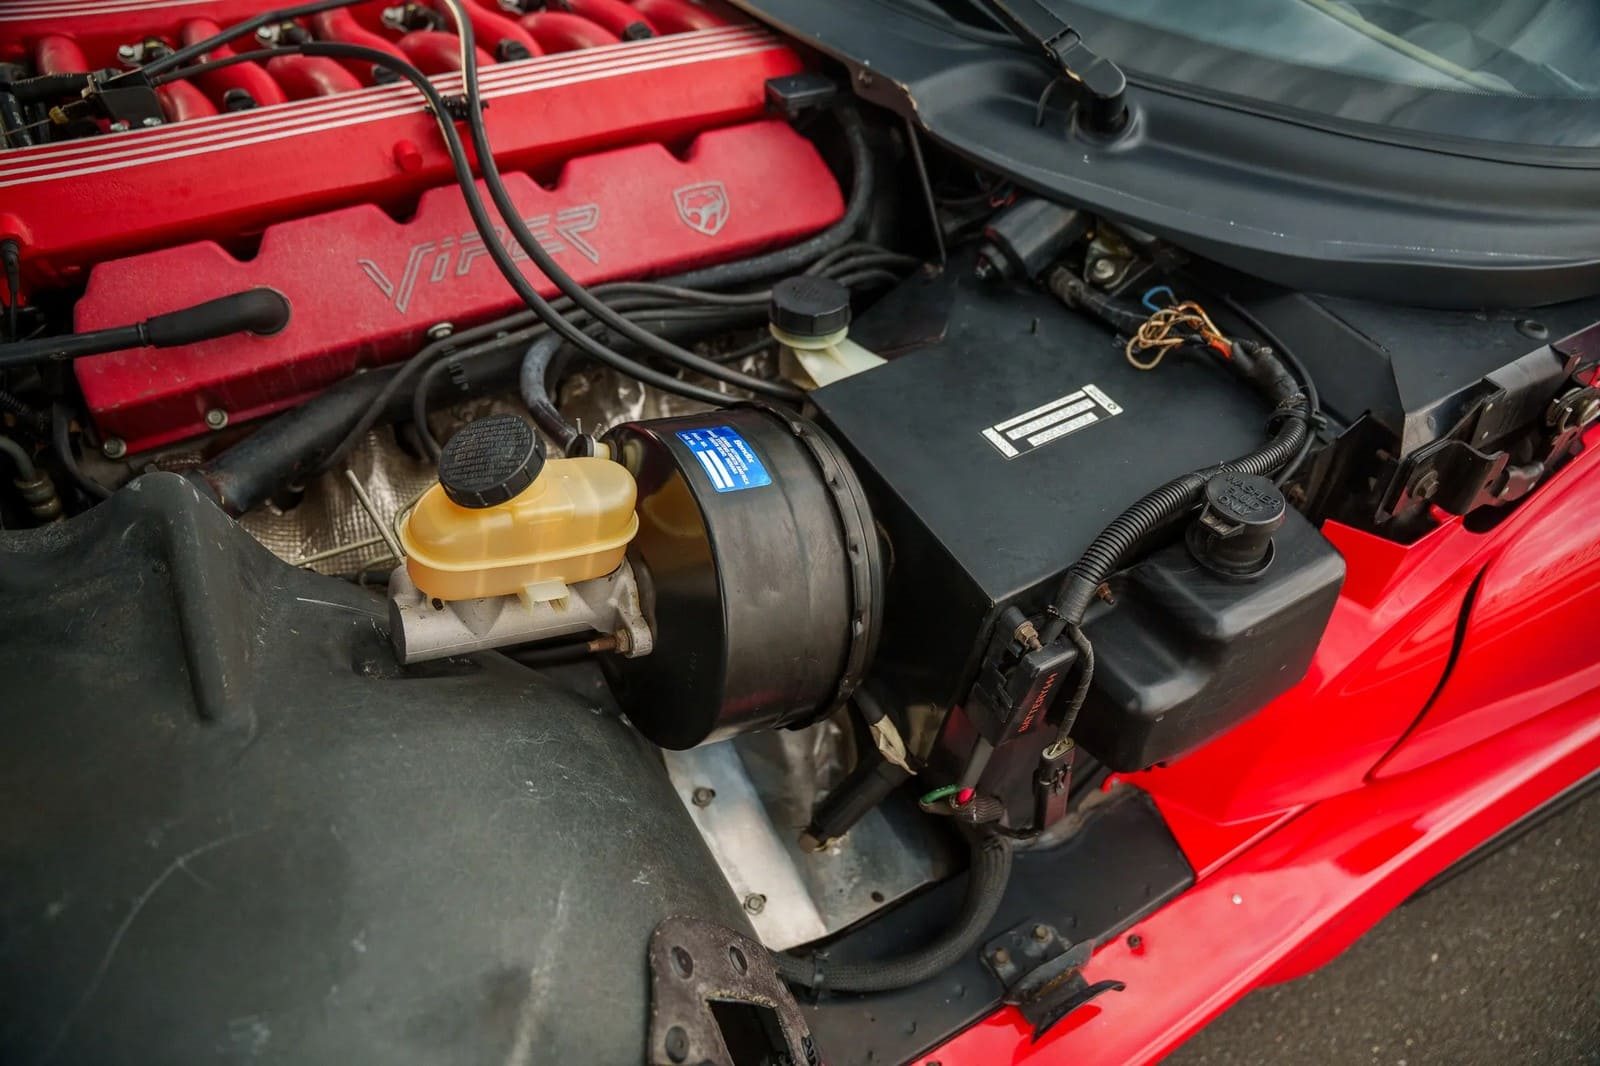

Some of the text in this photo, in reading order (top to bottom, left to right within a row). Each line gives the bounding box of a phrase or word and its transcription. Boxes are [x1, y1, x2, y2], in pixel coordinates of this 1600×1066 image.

[733, 439, 754, 462] Bendix
[1224, 488, 1263, 511] FLUID
[1226, 474, 1280, 509] WASHER
[1218, 495, 1251, 516] ONLY
